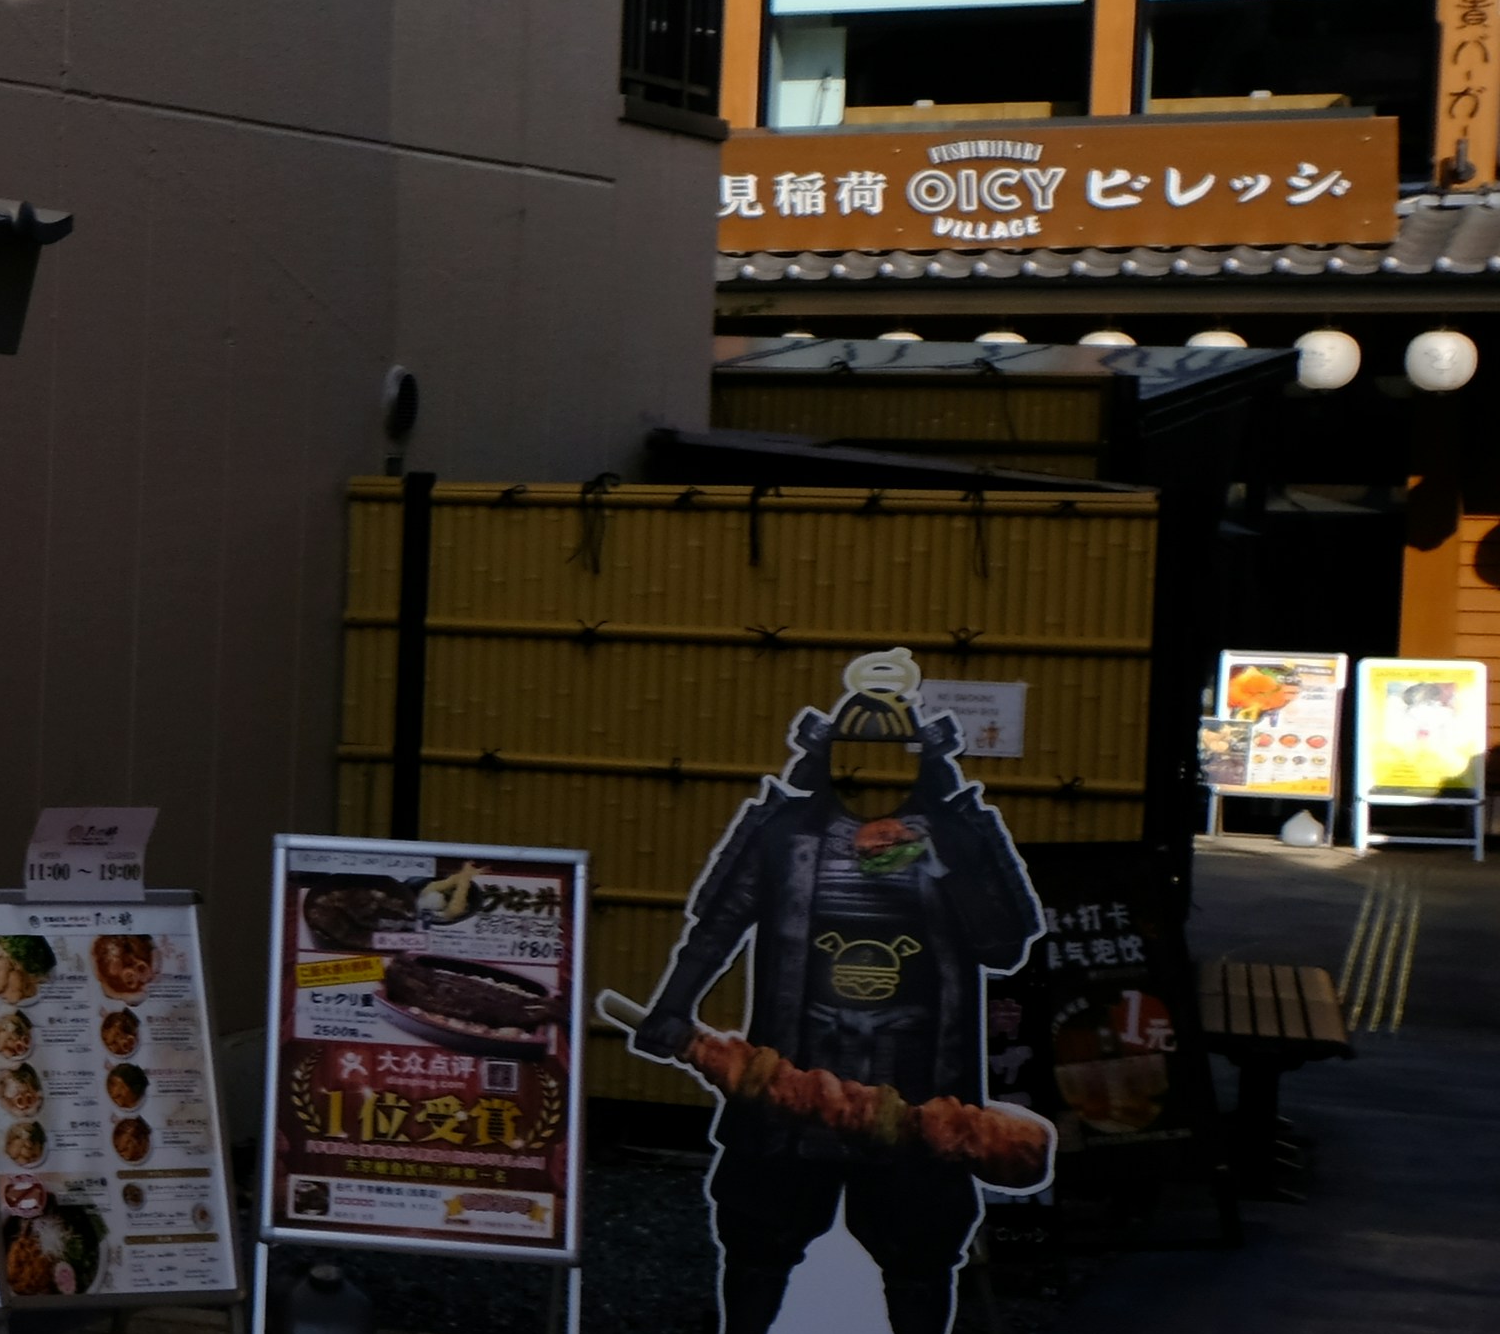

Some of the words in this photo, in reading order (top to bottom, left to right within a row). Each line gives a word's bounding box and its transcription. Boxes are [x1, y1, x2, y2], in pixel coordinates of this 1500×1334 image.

[717, 171, 887, 218] 見稲荷
[904, 166, 1067, 214] OICY
[1085, 160, 1353, 210] ビレッジ
[933, 215, 1043, 239] VILLAGE
[28, 863, 71, 881] 11:00
[99, 863, 141, 881] 19:00
[378, 1051, 476, 1078] 大众点评
[321, 1090, 523, 1149] 1位受賞
